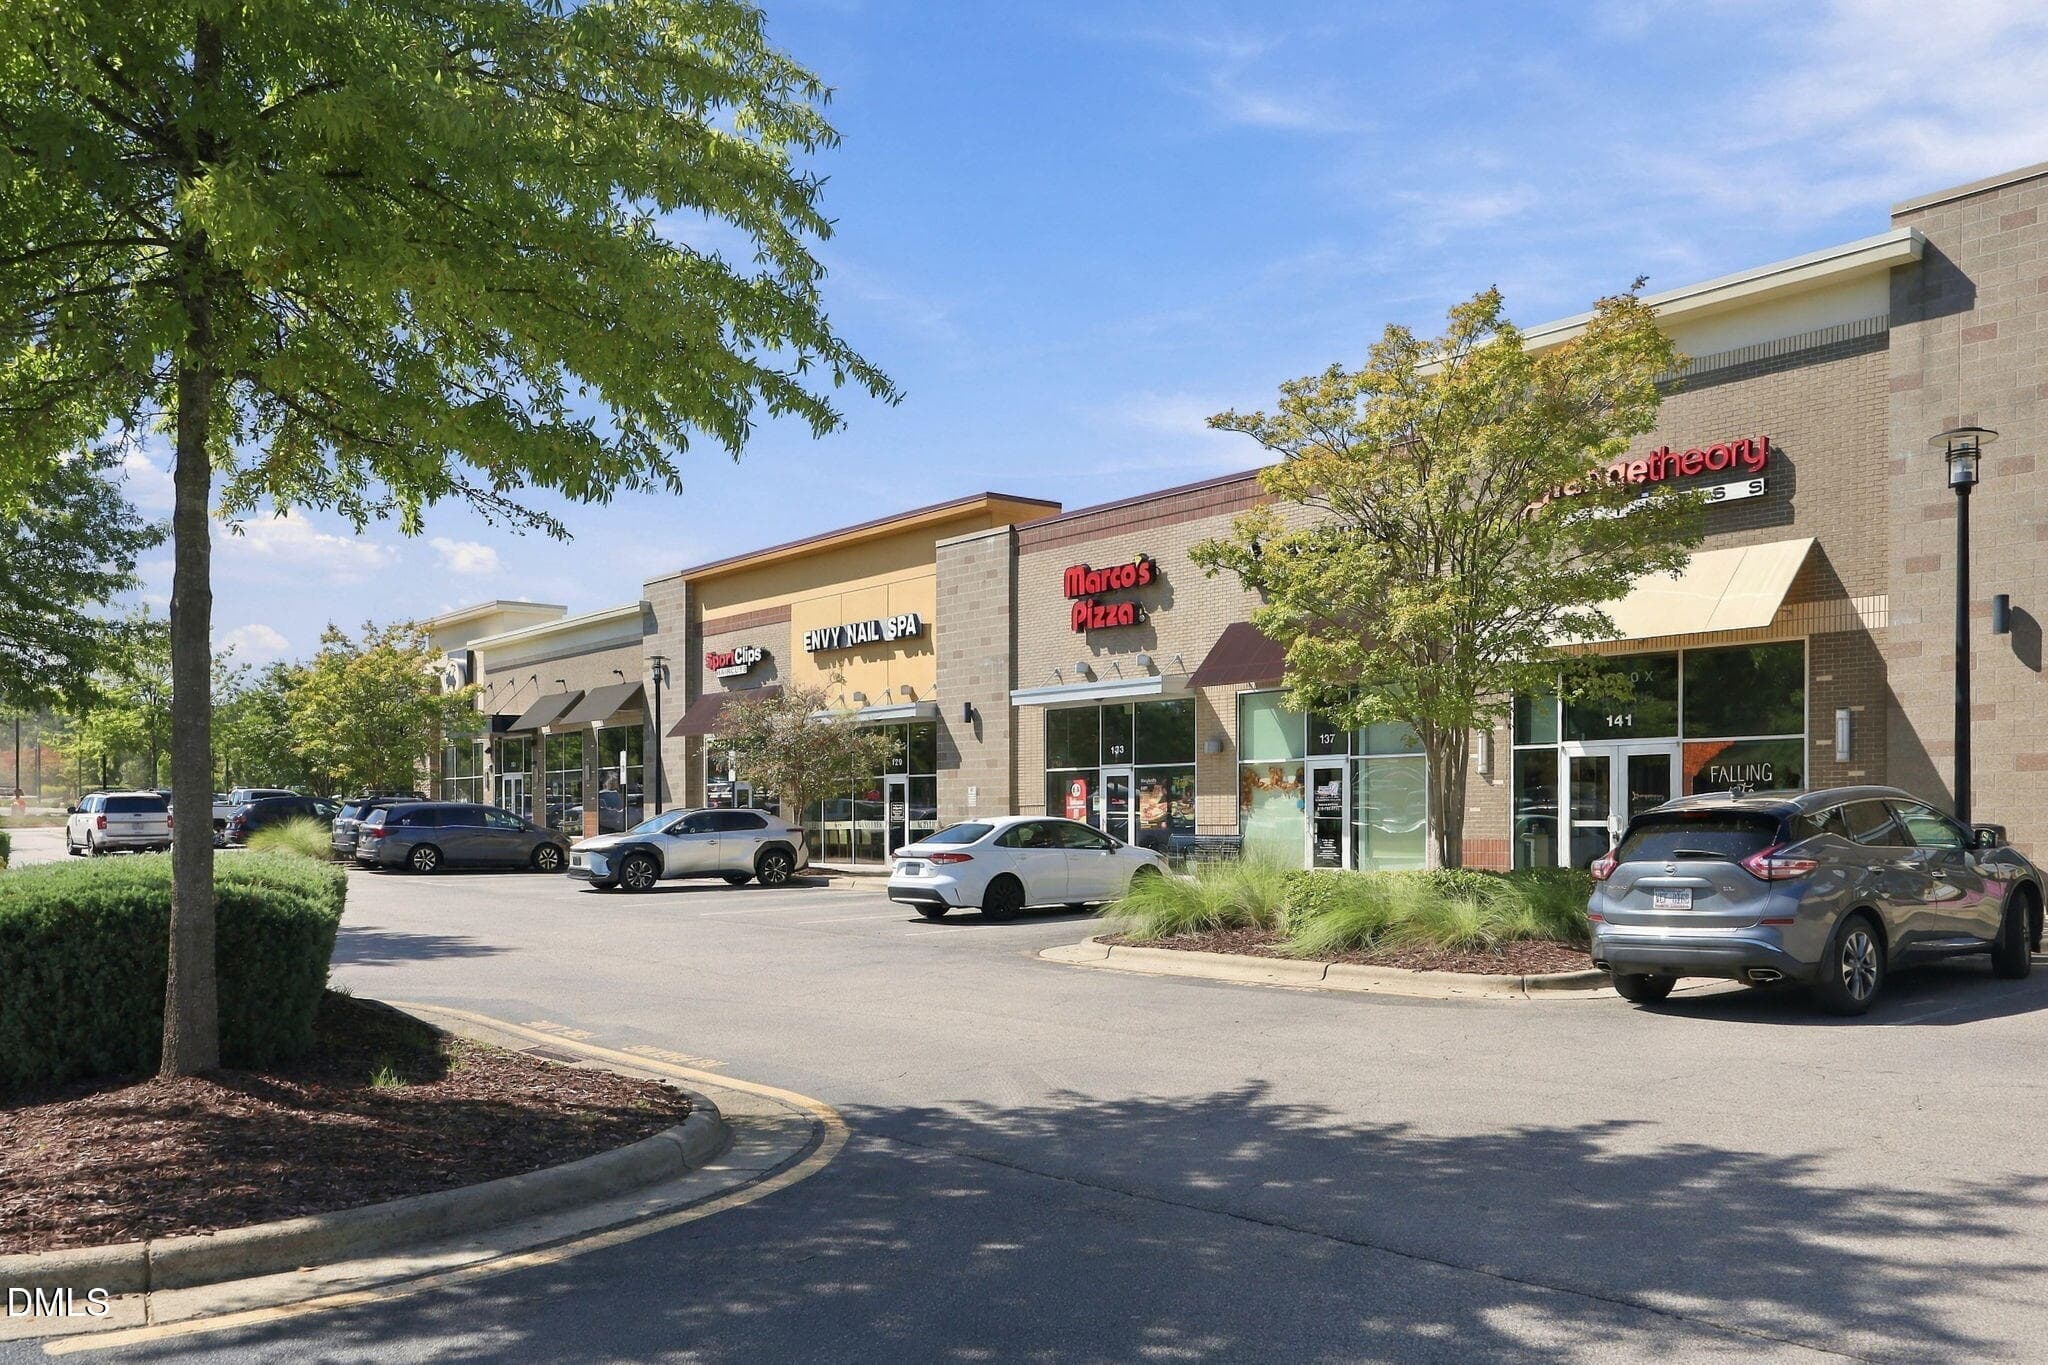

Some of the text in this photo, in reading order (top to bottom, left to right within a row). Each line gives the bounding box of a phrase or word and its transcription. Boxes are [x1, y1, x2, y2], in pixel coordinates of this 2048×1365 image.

[1064, 554, 1150, 598] Marco's
[1071, 598, 1134, 632] Pizza
[803, 614, 918, 651] ENVY NAIL SPA
[1606, 713, 1632, 727] 141
[1319, 733, 1336, 744] 137
[1110, 745, 1125, 755] 133
[1710, 762, 1773, 783] FALLING
